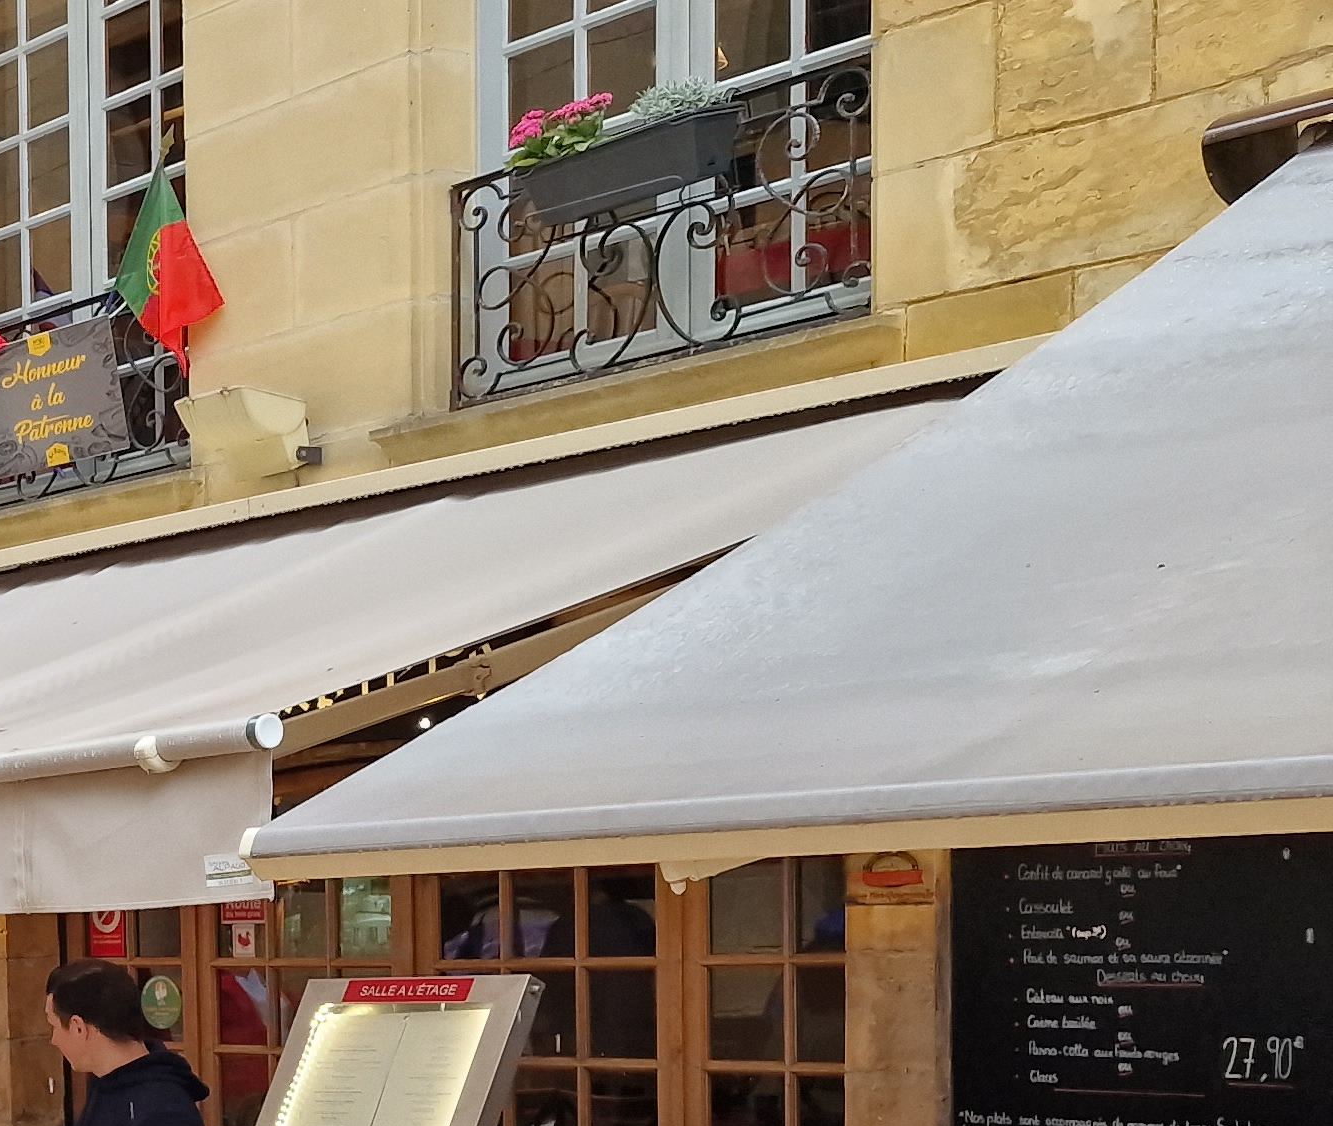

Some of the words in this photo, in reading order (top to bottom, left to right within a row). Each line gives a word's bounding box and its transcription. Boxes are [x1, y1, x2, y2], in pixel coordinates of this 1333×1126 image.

[2, 354, 87, 389] Honneur
[47, 382, 66, 406] la
[14, 414, 94, 445] Patronne
[360, 985, 397, 997] SALLE
